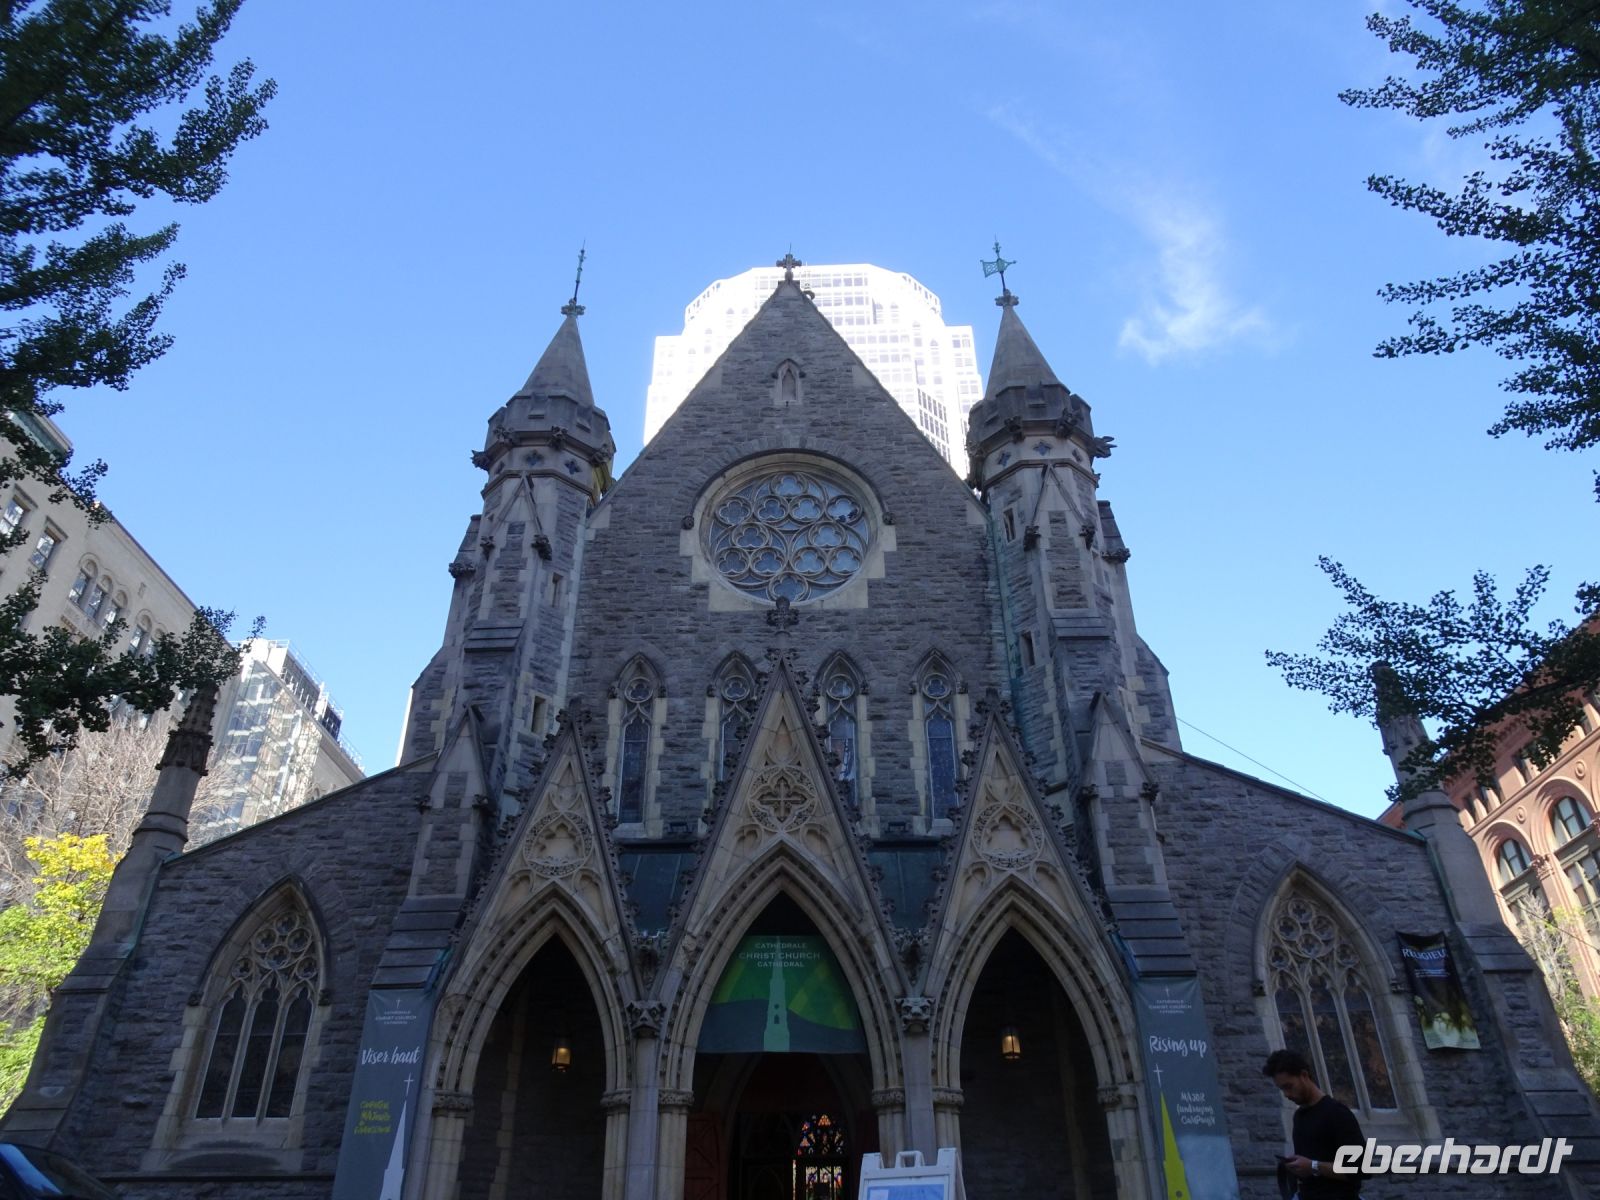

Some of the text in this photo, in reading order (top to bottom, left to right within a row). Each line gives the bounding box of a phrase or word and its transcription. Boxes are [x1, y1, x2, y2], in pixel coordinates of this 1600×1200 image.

[738, 952, 821, 960] CHRIST CHURCH
[361, 1046, 421, 1066] Viser haut
[1149, 1035, 1207, 1058] Rising up
